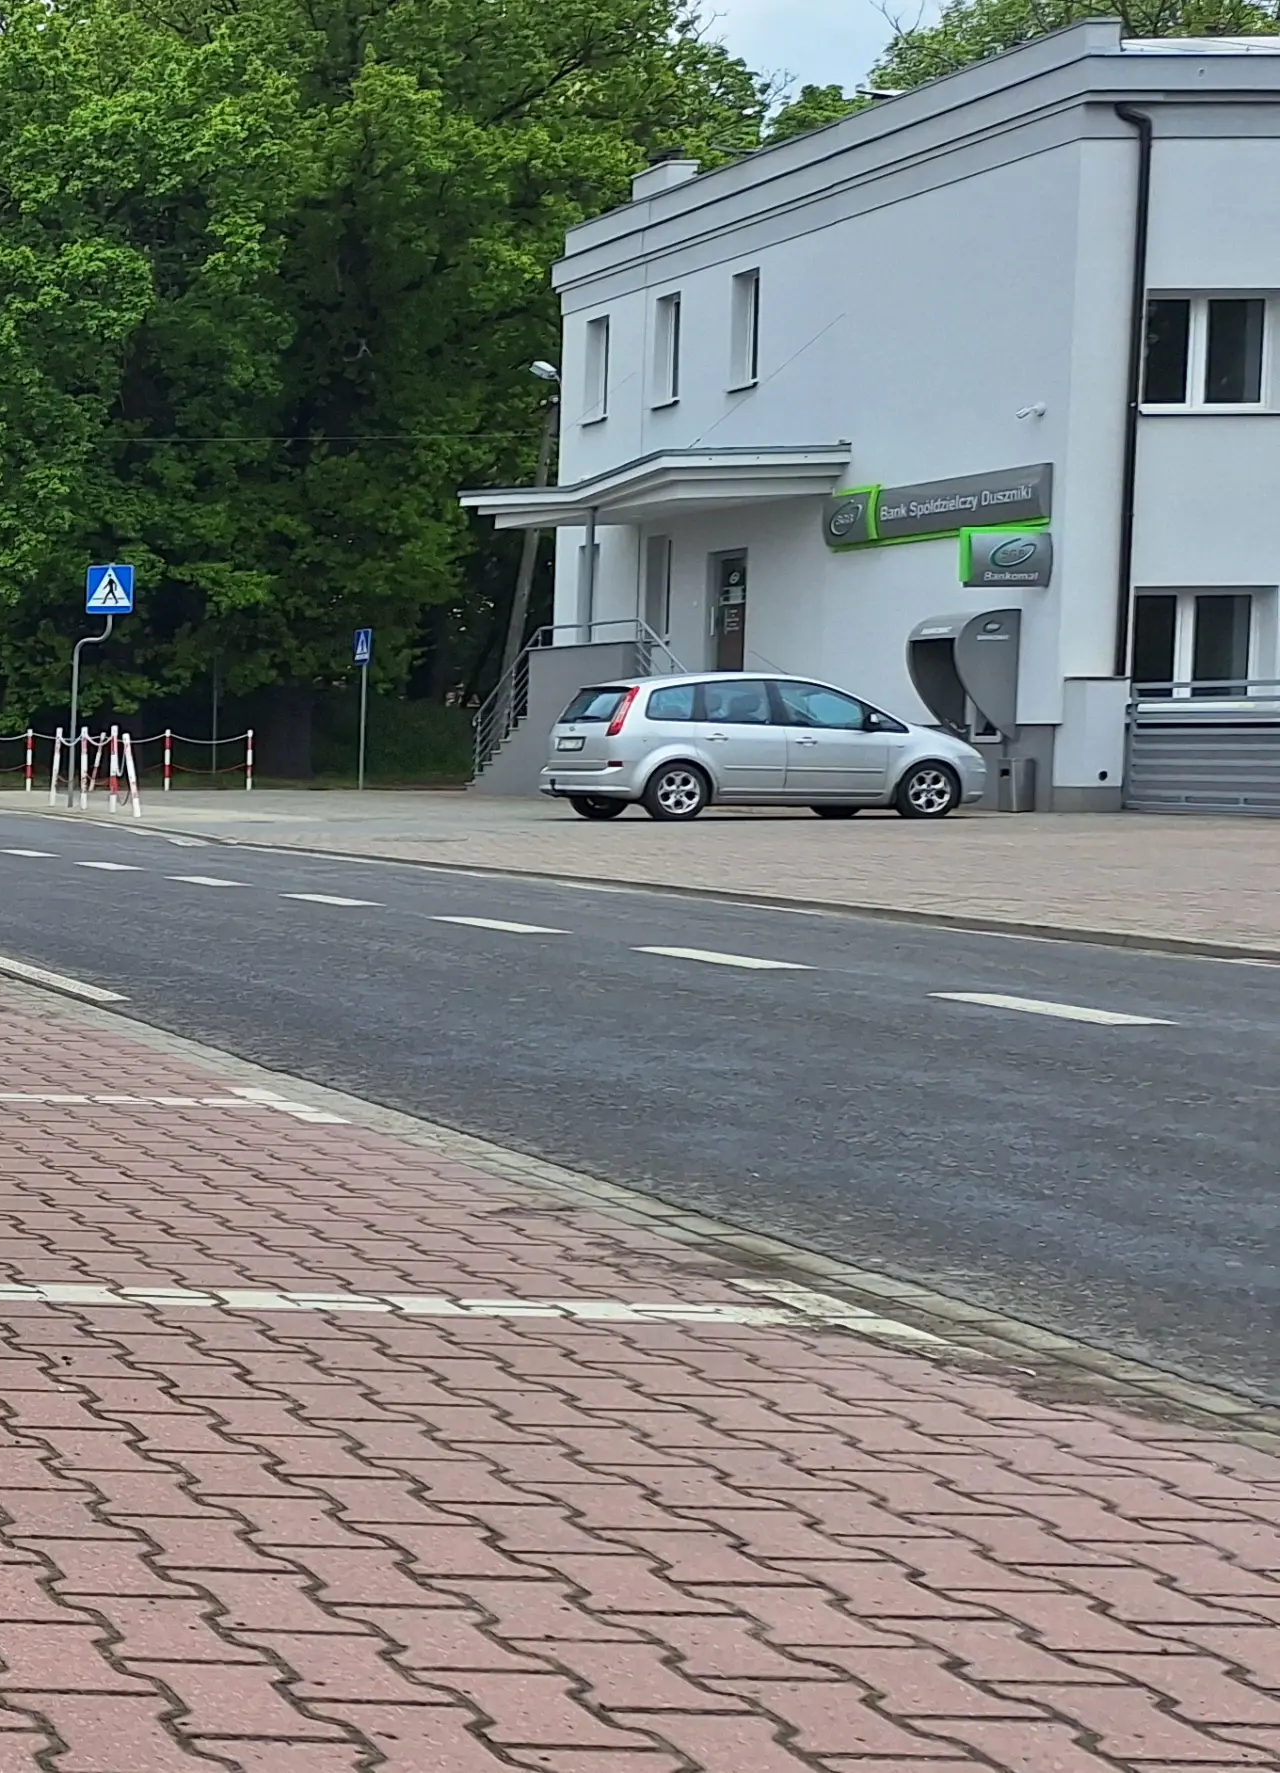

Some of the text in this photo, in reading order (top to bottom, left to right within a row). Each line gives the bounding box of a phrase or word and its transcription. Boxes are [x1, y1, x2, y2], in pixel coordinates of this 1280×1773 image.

[880, 503, 907, 521] Bank
[981, 483, 1032, 506] Duszniki
[983, 570, 1040, 581] Bankomat
